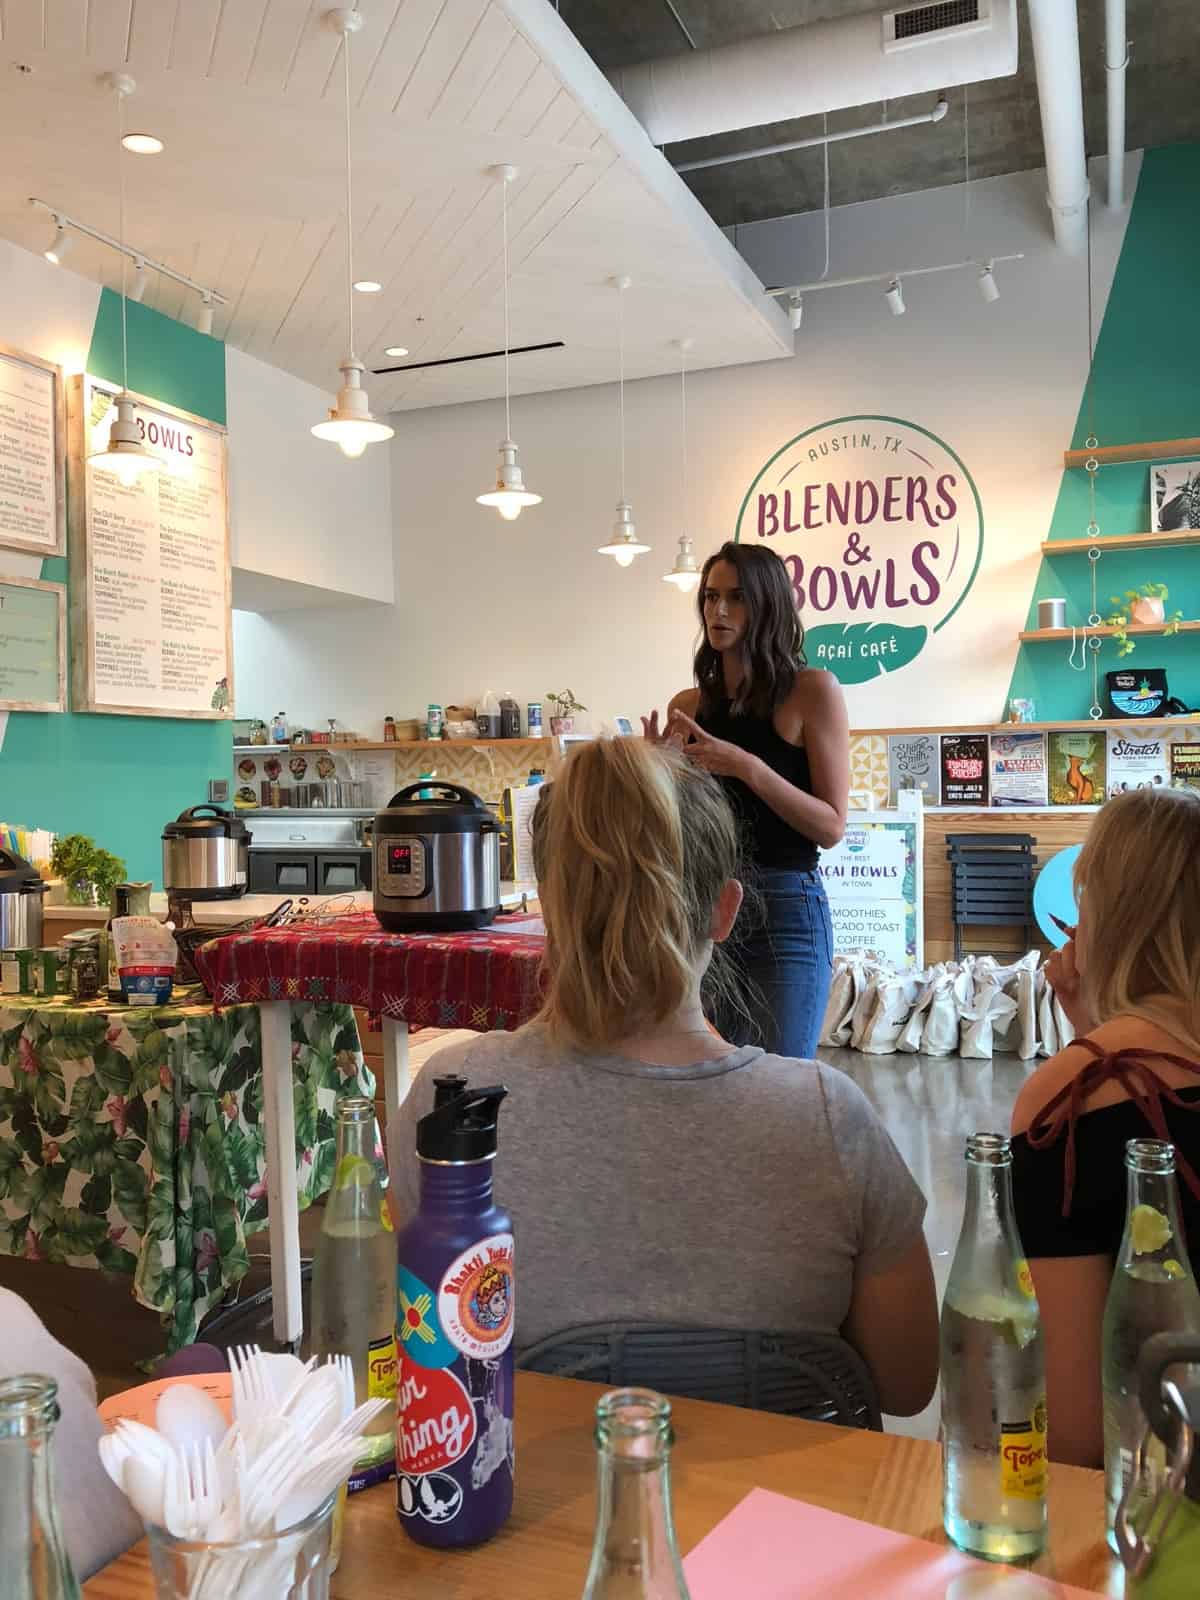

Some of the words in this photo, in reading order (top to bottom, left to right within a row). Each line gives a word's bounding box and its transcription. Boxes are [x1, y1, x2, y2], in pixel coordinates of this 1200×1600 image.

[137, 417, 194, 457] BOWLS
[807, 433, 877, 463] AUSTIN,
[883, 436, 903, 453] TX
[757, 474, 957, 537] BLENDERS
[843, 532, 872, 566] &
[783, 541, 941, 611] BOWLS
[860, 637, 899, 657] CAFÉ
[1112, 739, 1162, 756] Stretch
[393, 849, 410, 858] OFF
[851, 866, 898, 878] BOWLS
[832, 908, 887, 919] MOOTHIES
[833, 922, 865, 932] CADO
[866, 922, 901, 932] TOAST
[836, 935, 877, 945] COFFEE
[443, 1254, 484, 1296] Bhakti
